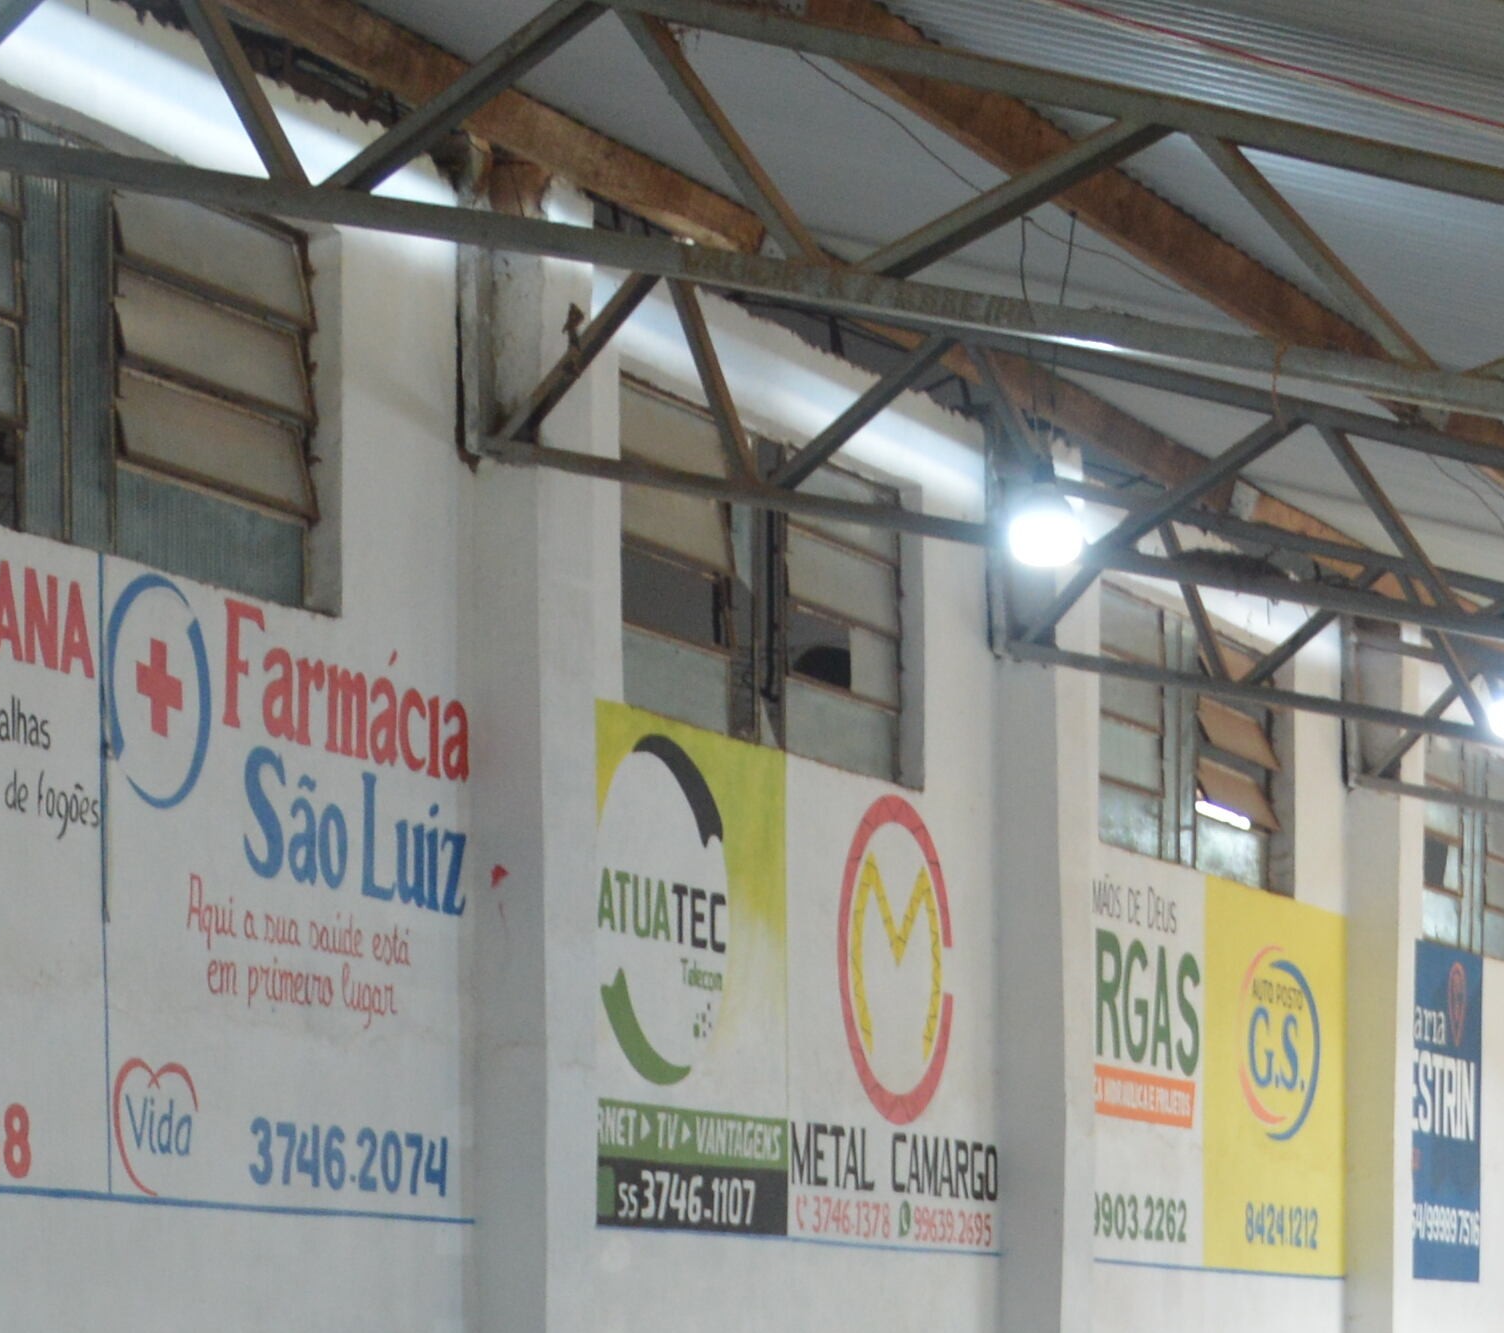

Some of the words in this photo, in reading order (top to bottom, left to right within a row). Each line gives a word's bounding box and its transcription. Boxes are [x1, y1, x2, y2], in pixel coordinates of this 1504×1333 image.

[222, 597, 470, 783] Farmácia
[4, 769, 29, 813] de
[37, 770, 100, 840] fogões
[243, 745, 348, 890] São
[360, 770, 467, 917] Luiz
[187, 872, 238, 951] Aqui
[243, 909, 259, 940] a
[263, 912, 301, 947] sua
[207, 958, 239, 996] em
[341, 962, 399, 1030] lugar
[124, 1092, 193, 1157] Vida
[248, 1116, 449, 1198] 3746.2074
[657, 1111, 680, 1151] TV
[696, 1114, 783, 1162] VANTAGENS
[790, 1120, 876, 1192] METAL
[890, 1131, 999, 1202] CAMARGO
[640, 1168, 757, 1227] 3746.1107
